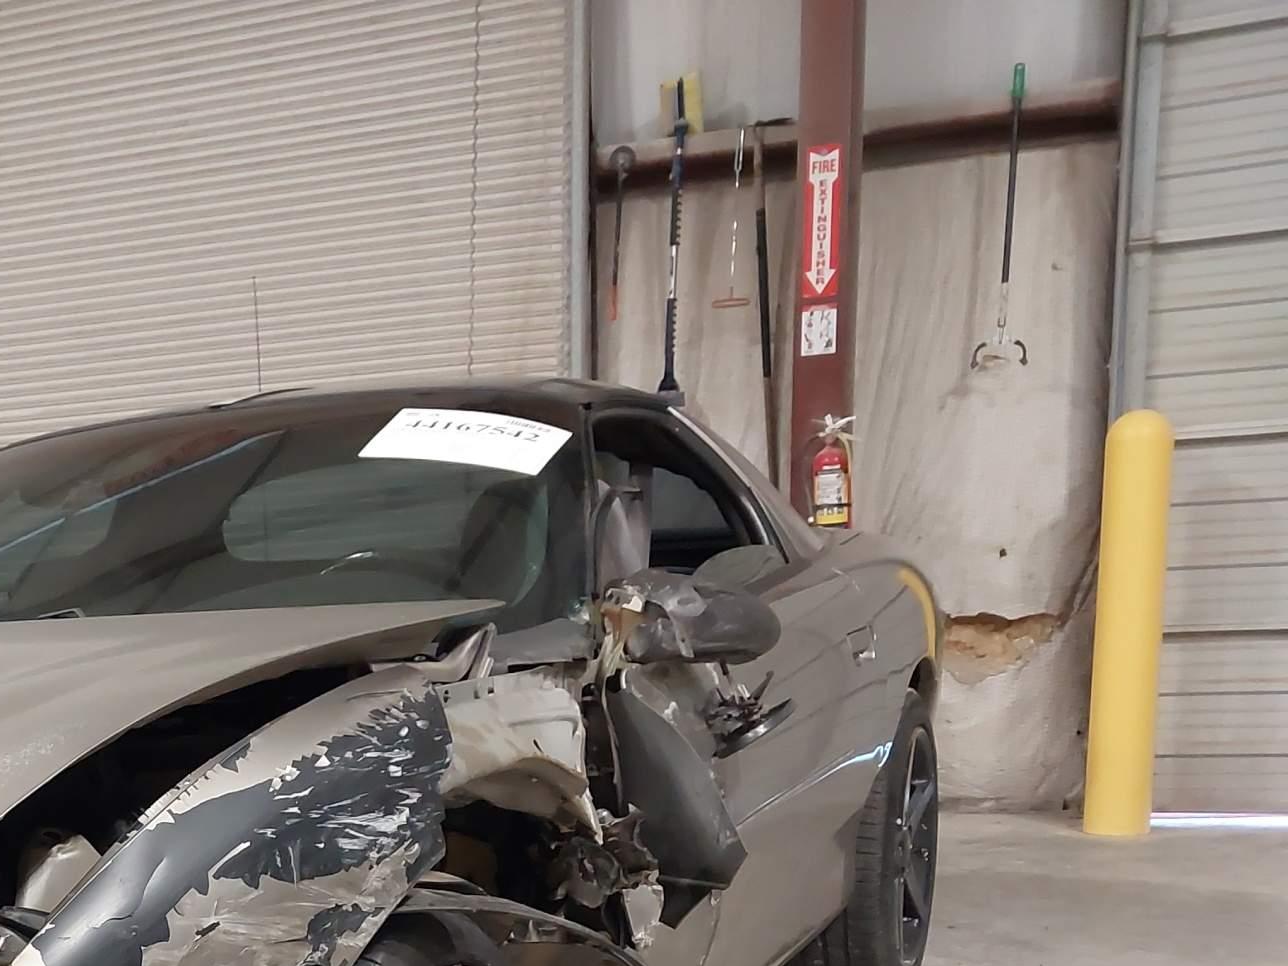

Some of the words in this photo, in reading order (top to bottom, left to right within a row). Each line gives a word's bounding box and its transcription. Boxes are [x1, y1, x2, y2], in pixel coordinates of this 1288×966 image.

[812, 159, 837, 174] FIRE
[815, 179, 827, 286] EXTINGUISHER
[405, 420, 540, 442] 44167542
